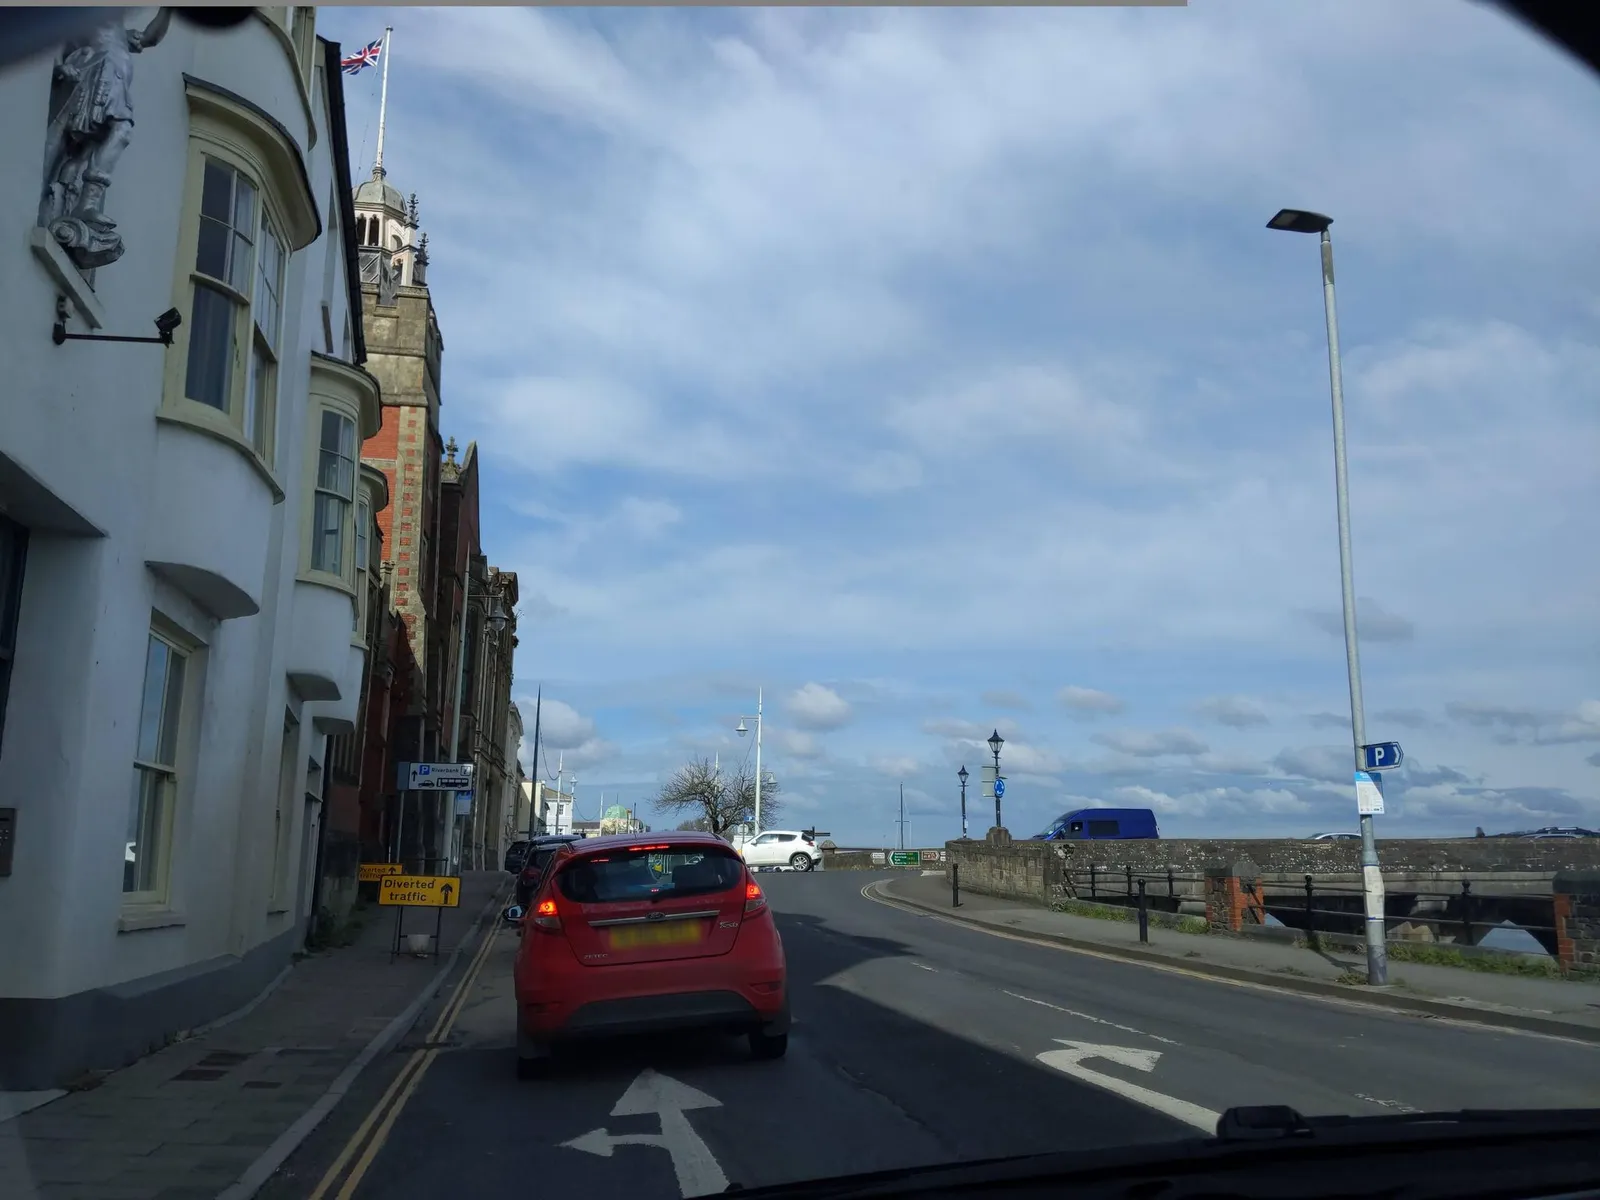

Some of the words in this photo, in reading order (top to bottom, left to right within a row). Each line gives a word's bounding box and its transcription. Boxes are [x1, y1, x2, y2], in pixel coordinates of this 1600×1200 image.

[1375, 747, 1385, 766] P
[384, 879, 435, 889] Diverted
[389, 891, 427, 902] traffic
